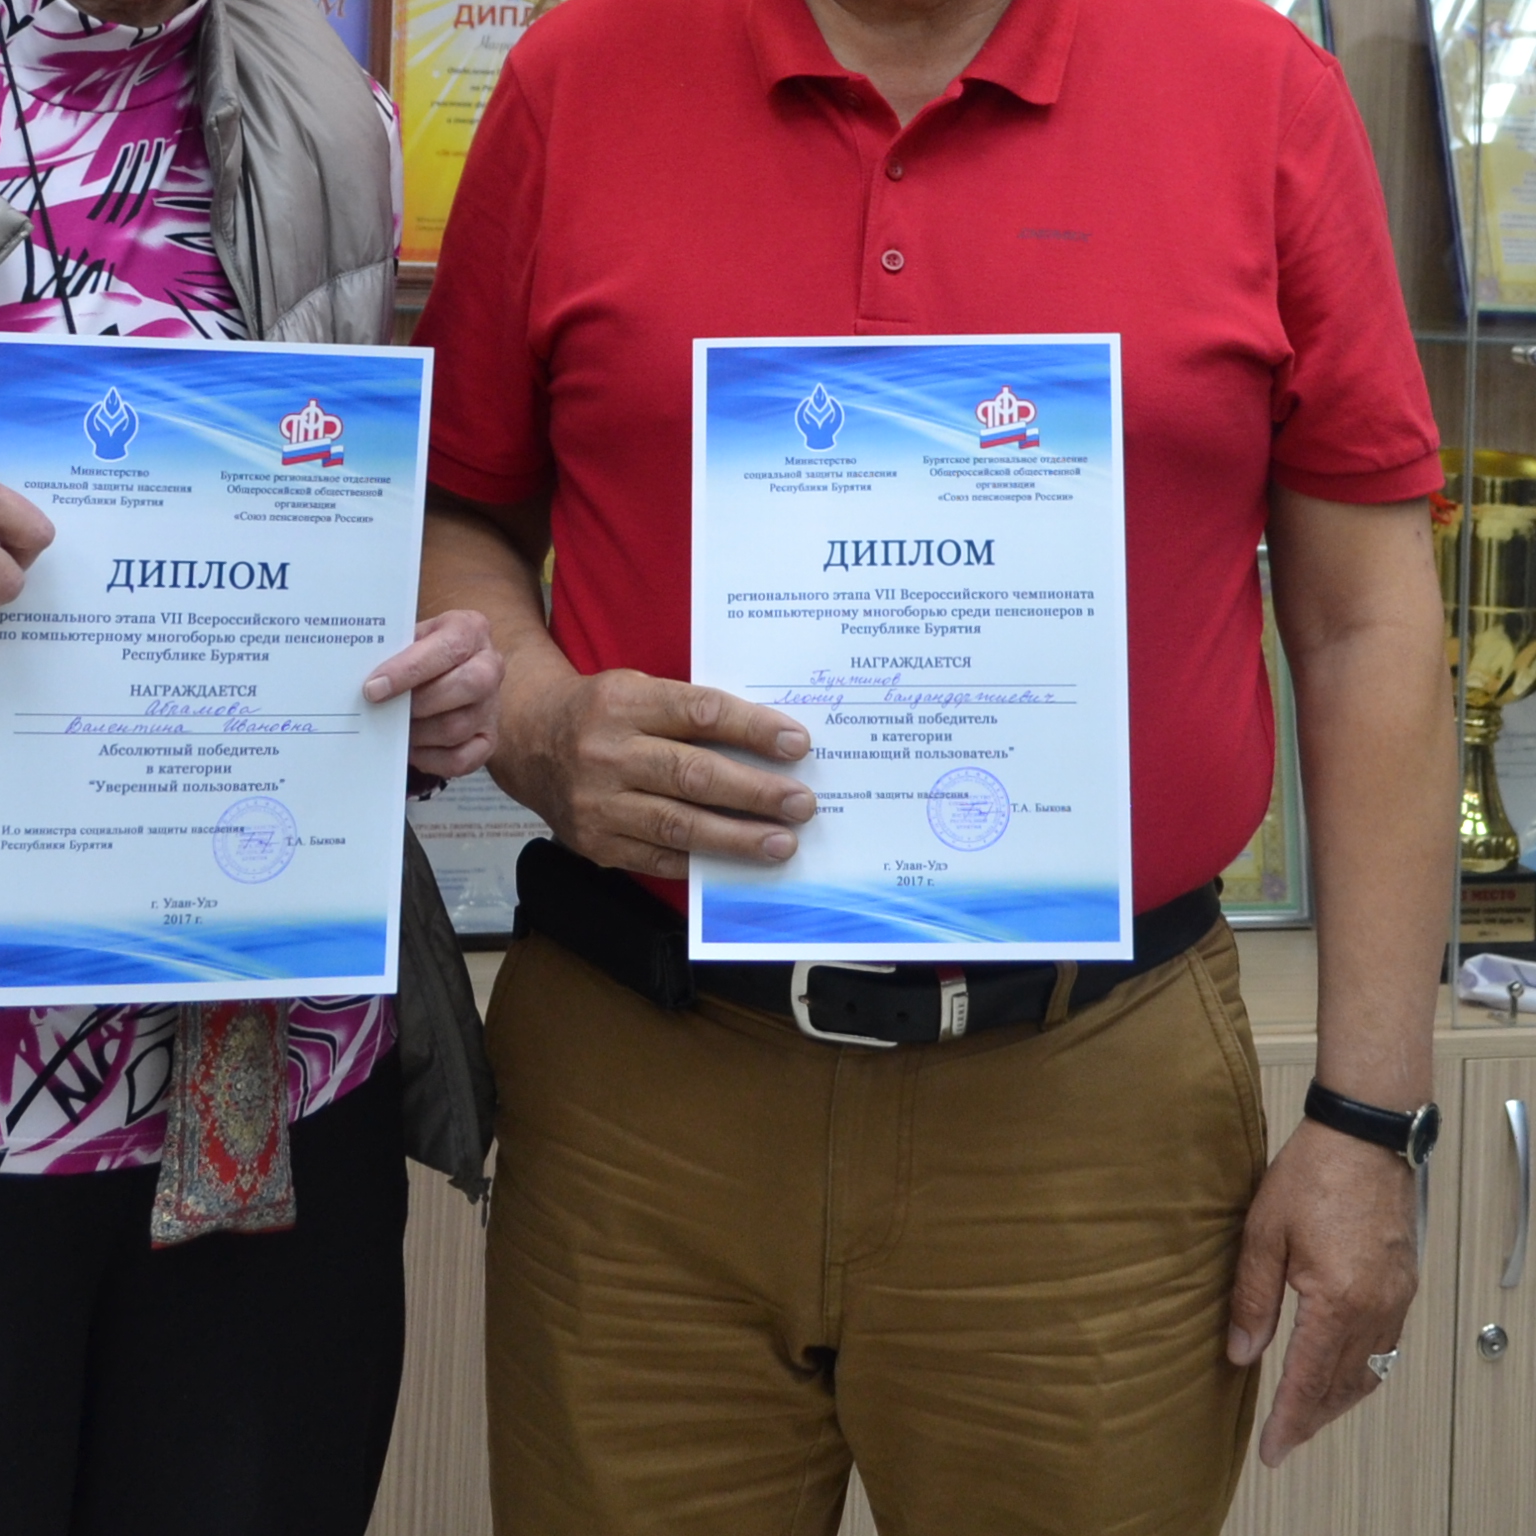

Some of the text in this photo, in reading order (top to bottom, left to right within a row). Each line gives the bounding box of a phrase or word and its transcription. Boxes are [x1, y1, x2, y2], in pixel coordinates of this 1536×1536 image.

[785, 455, 856, 466] Министерство
[923, 455, 1088, 467] Бурятское региональное отделение
[70, 467, 149, 478] Министерство
[220, 471, 391, 485] Бурятское региональное отделение
[744, 468, 897, 481] социальной защиты населения
[930, 467, 1081, 479] Общероссийской общественной
[24, 480, 192, 494] социальной защиты населения
[226, 485, 383, 499] Общероссийской общественной
[769, 482, 872, 494] Республики Бурятия
[52, 495, 164, 508] Республики Бурятия
[823, 538, 995, 573] ДИПЛОМ
[107, 559, 290, 593] ДИПЛОМ
[727, 588, 1095, 604] регионального этапа VII Всероссийского чемпионата
[0, 611, 386, 628] регионального этапа VII Всероссийского чемпионата
[728, 606, 1094, 622] по компьютерному многоборью среди пенсионеров в
[841, 623, 981, 638] Республике Бурятия
[21, 629, 142, 645] компьютерному
[146, 631, 235, 646] многоборью
[239, 633, 280, 647] среди
[284, 634, 373, 647] пенсионеров
[378, 635, 384, 644] в
[122, 648, 269, 664] Республике Бурятия
[850, 656, 971, 670] НАГРАЖДАЕТСЯ
[129, 684, 257, 698] НАГРАЖДАЕТСЯ
[825, 712, 997, 727] Абсолютный победитель
[871, 731, 952, 745] в категории
[98, 743, 279, 759] Абсолютный победитель
[146, 763, 232, 777] в категории
[875, 790, 913, 801] защиты
[1035, 803, 1071, 813] Быкова
[24, 826, 77, 838] министра
[80, 824, 144, 836] социальной
[148, 824, 188, 836] защиты
[1, 839, 65, 852] Республики
[69, 839, 113, 851] Бурятия
[310, 835, 345, 846] Быкова
[884, 859, 948, 873] г. Улан-Удэ
[896, 876, 934, 887] 2017 г.
[151, 897, 218, 911] г. Улан-Удэ
[163, 914, 202, 925] 2017 г.
